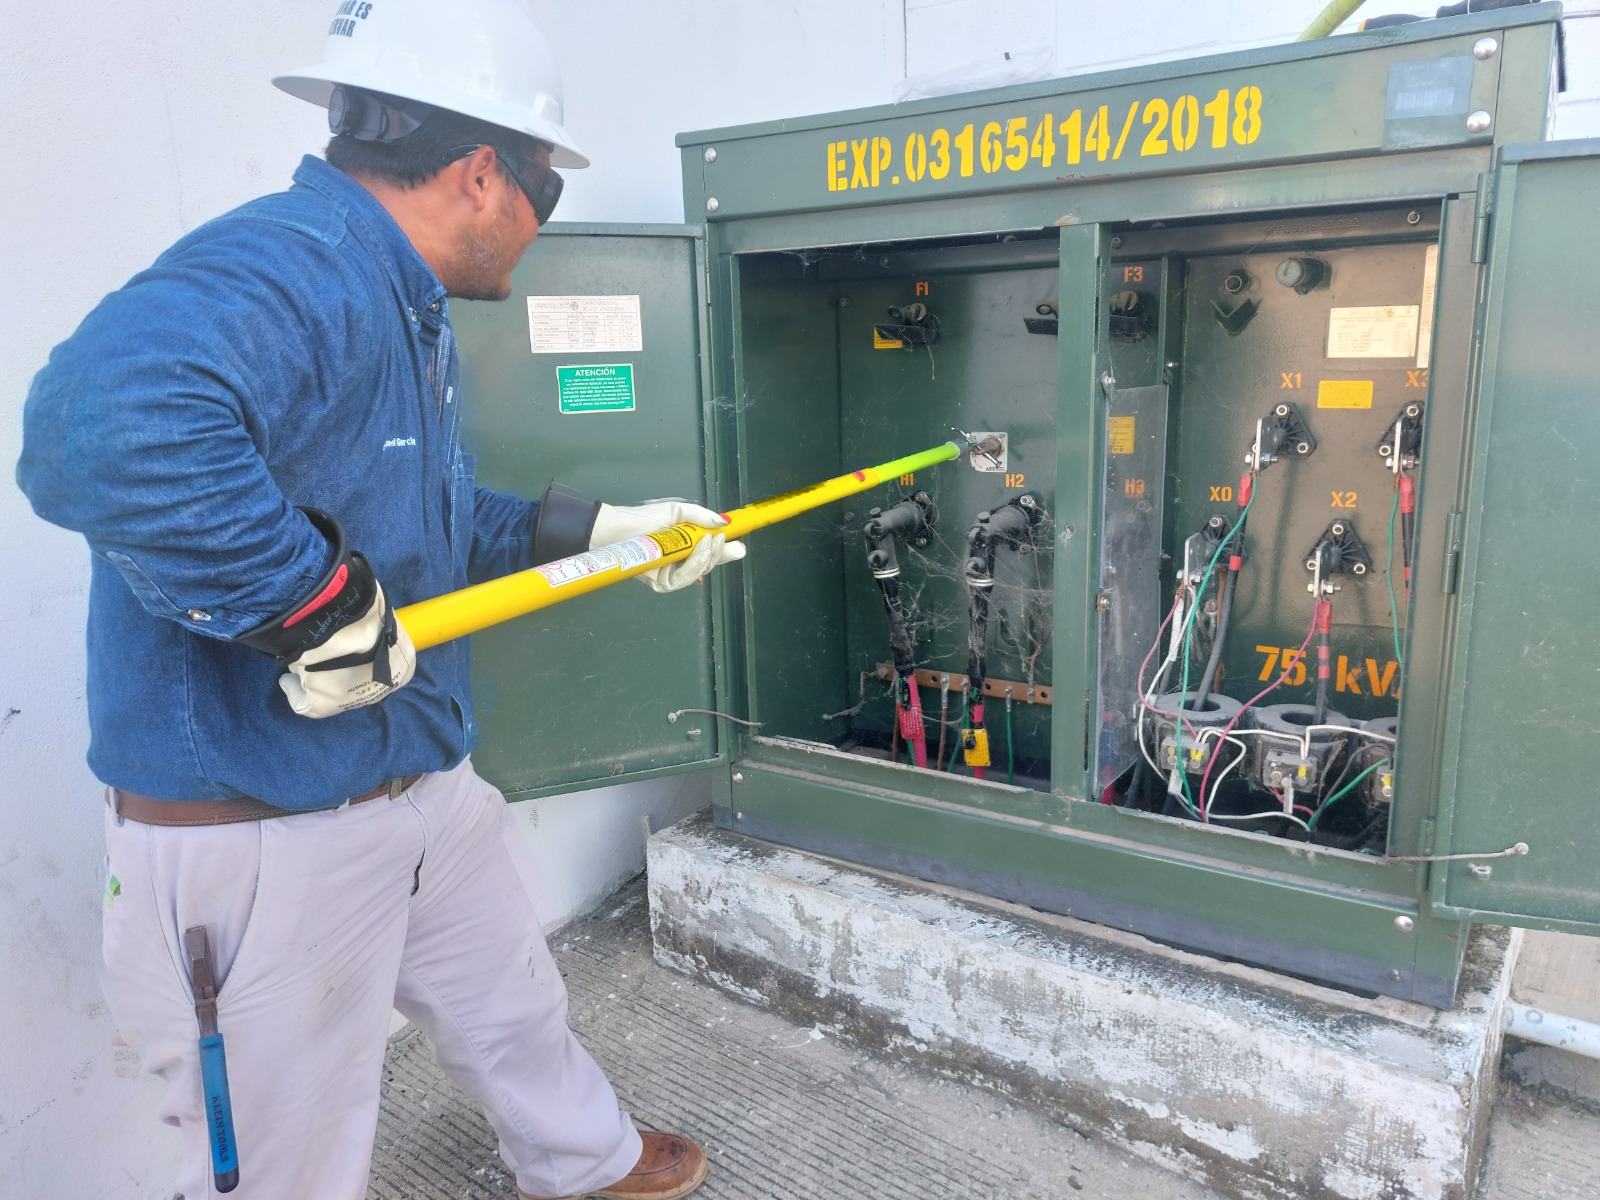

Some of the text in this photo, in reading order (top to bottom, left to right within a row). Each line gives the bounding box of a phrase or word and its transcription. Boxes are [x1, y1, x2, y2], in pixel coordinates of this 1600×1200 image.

[354, 2, 373, 20] ES
[827, 86, 1263, 192] EXP.03165414/2018
[1124, 266, 1143, 282] F3
[916, 281, 929, 296] F1
[574, 367, 616, 377] ATENCIÓN
[1281, 372, 1302, 388] X1
[900, 473, 914, 486] H1
[1005, 474, 1025, 488] H2
[1124, 479, 1145, 495] H3
[1330, 491, 1358, 508] X2
[1256, 645, 1401, 699] 75 kV
[212, 1094, 230, 1163] KLEIN TOOLS
